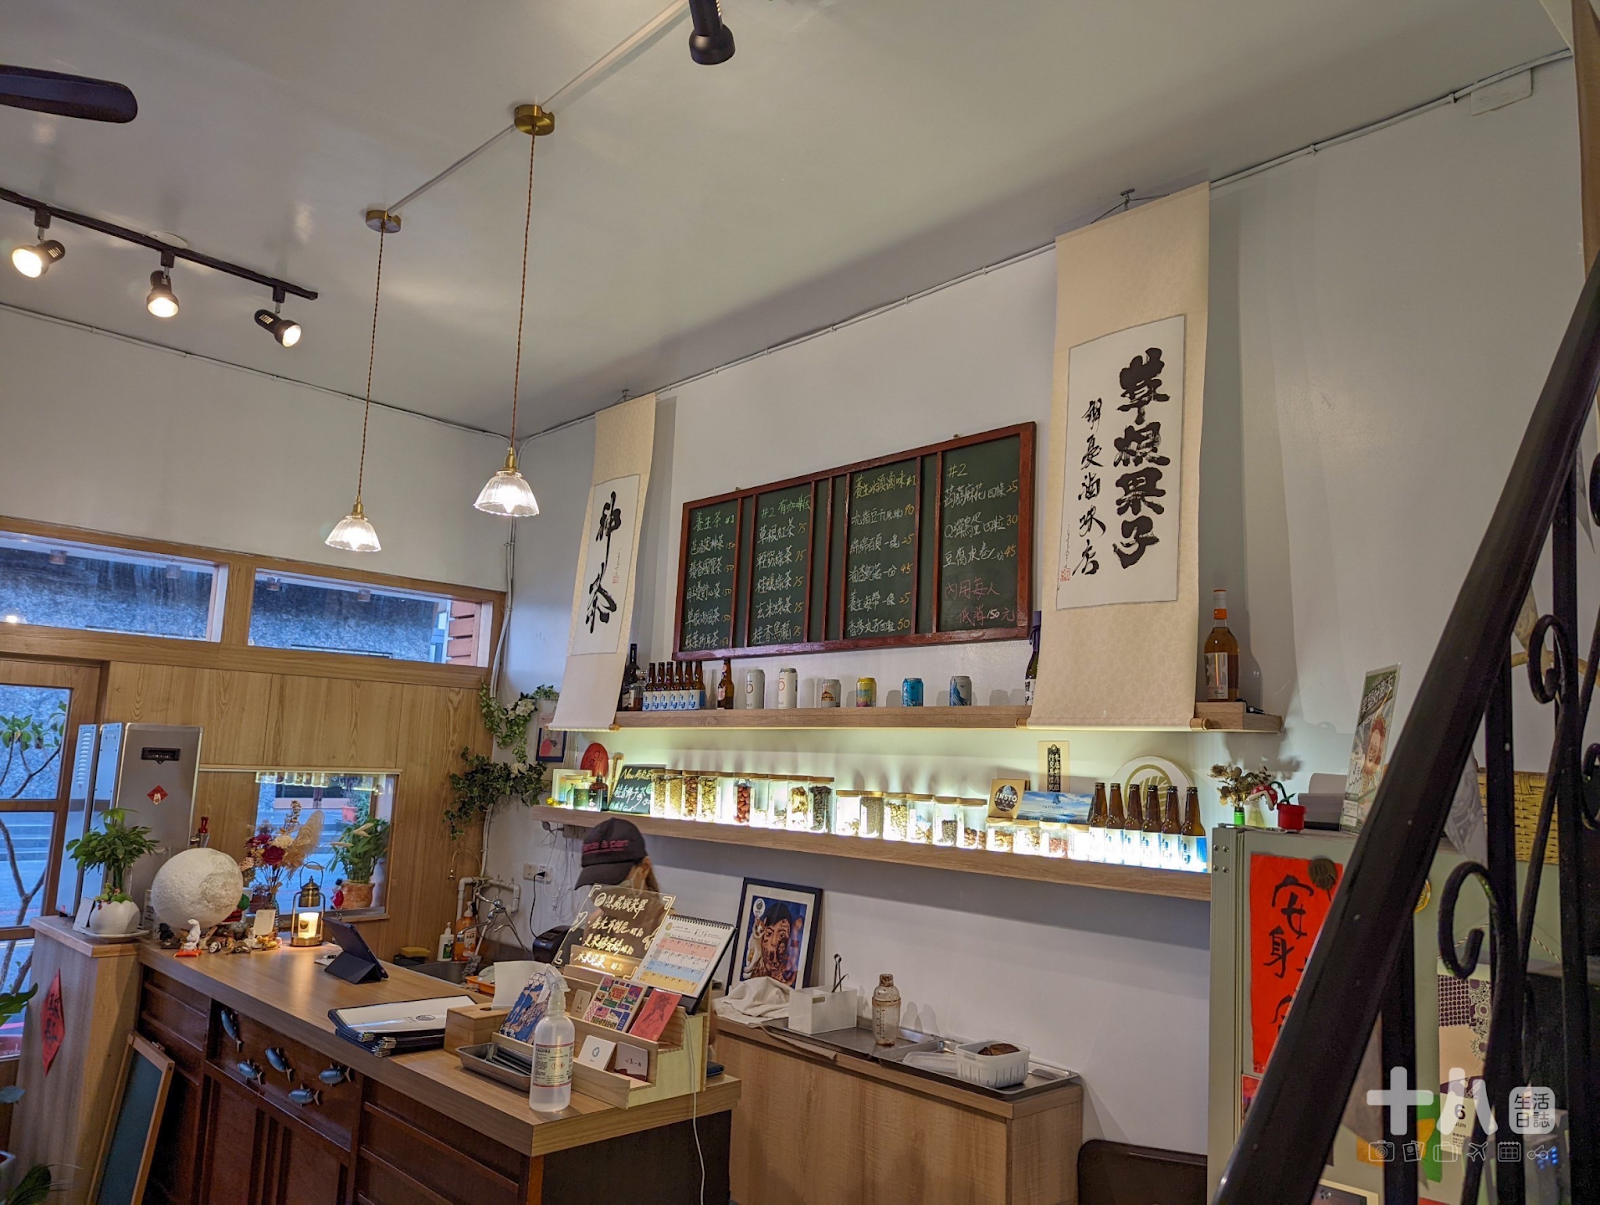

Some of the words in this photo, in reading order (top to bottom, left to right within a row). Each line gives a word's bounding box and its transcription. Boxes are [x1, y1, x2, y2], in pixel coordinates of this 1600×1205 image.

[1112, 347, 1171, 569] 草根果子
[947, 463, 968, 478] #2
[1006, 479, 1019, 493] 25
[761, 507, 776, 517] #2
[693, 511, 721, 532] 養生茶
[1006, 514, 1018, 527] 30
[757, 517, 795, 544] 草根紅茶
[902, 533, 914, 545] 25
[1004, 544, 1016, 558] 45
[901, 562, 913, 575] 45
[899, 592, 911, 604] 25
[898, 615, 910, 630] 50
[1454, 1103, 1466, 1120] 6
